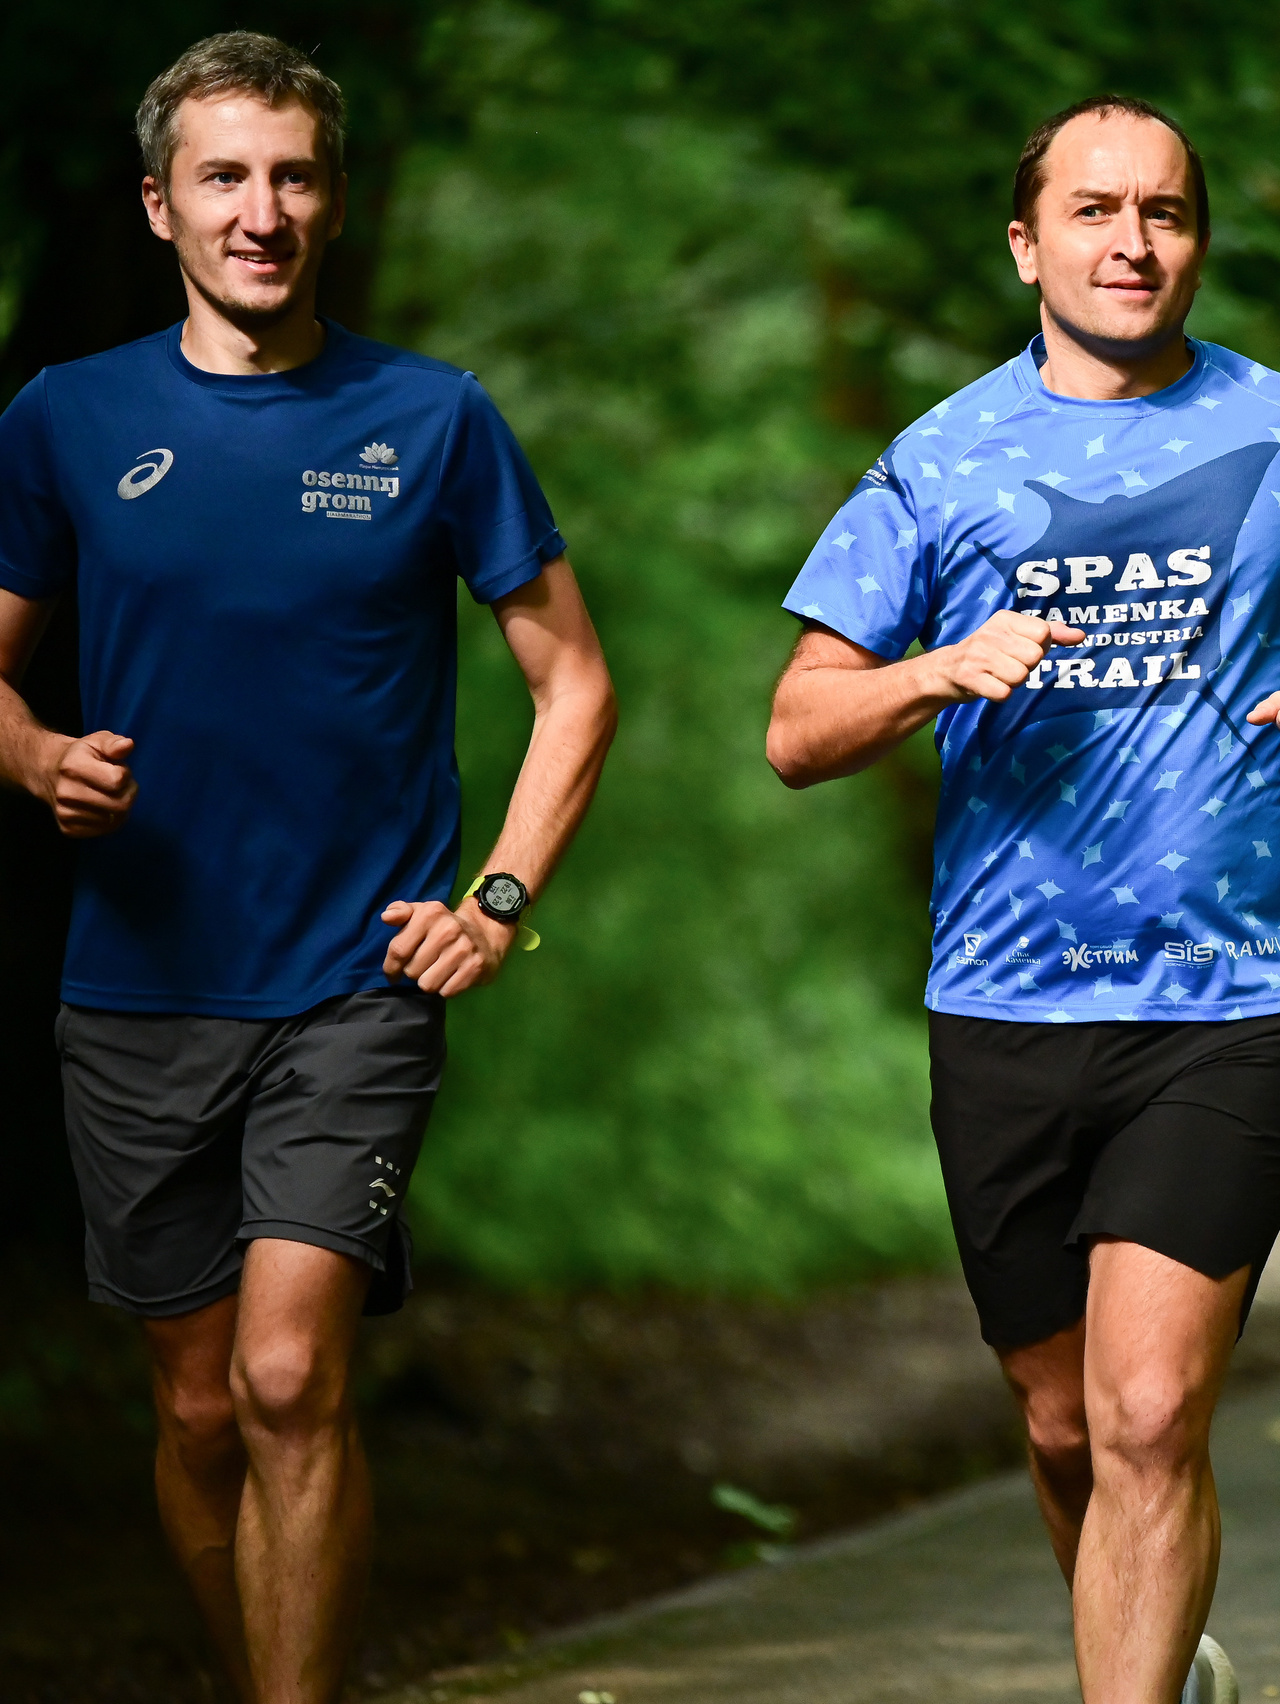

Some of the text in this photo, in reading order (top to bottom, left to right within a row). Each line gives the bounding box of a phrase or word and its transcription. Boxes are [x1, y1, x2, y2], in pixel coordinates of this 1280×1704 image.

[301, 491, 371, 513] grom
[1015, 545, 1212, 598] SPAS
[1064, 626, 1204, 649] NDUSTRIA
[1025, 651, 1201, 690] TRAIL
